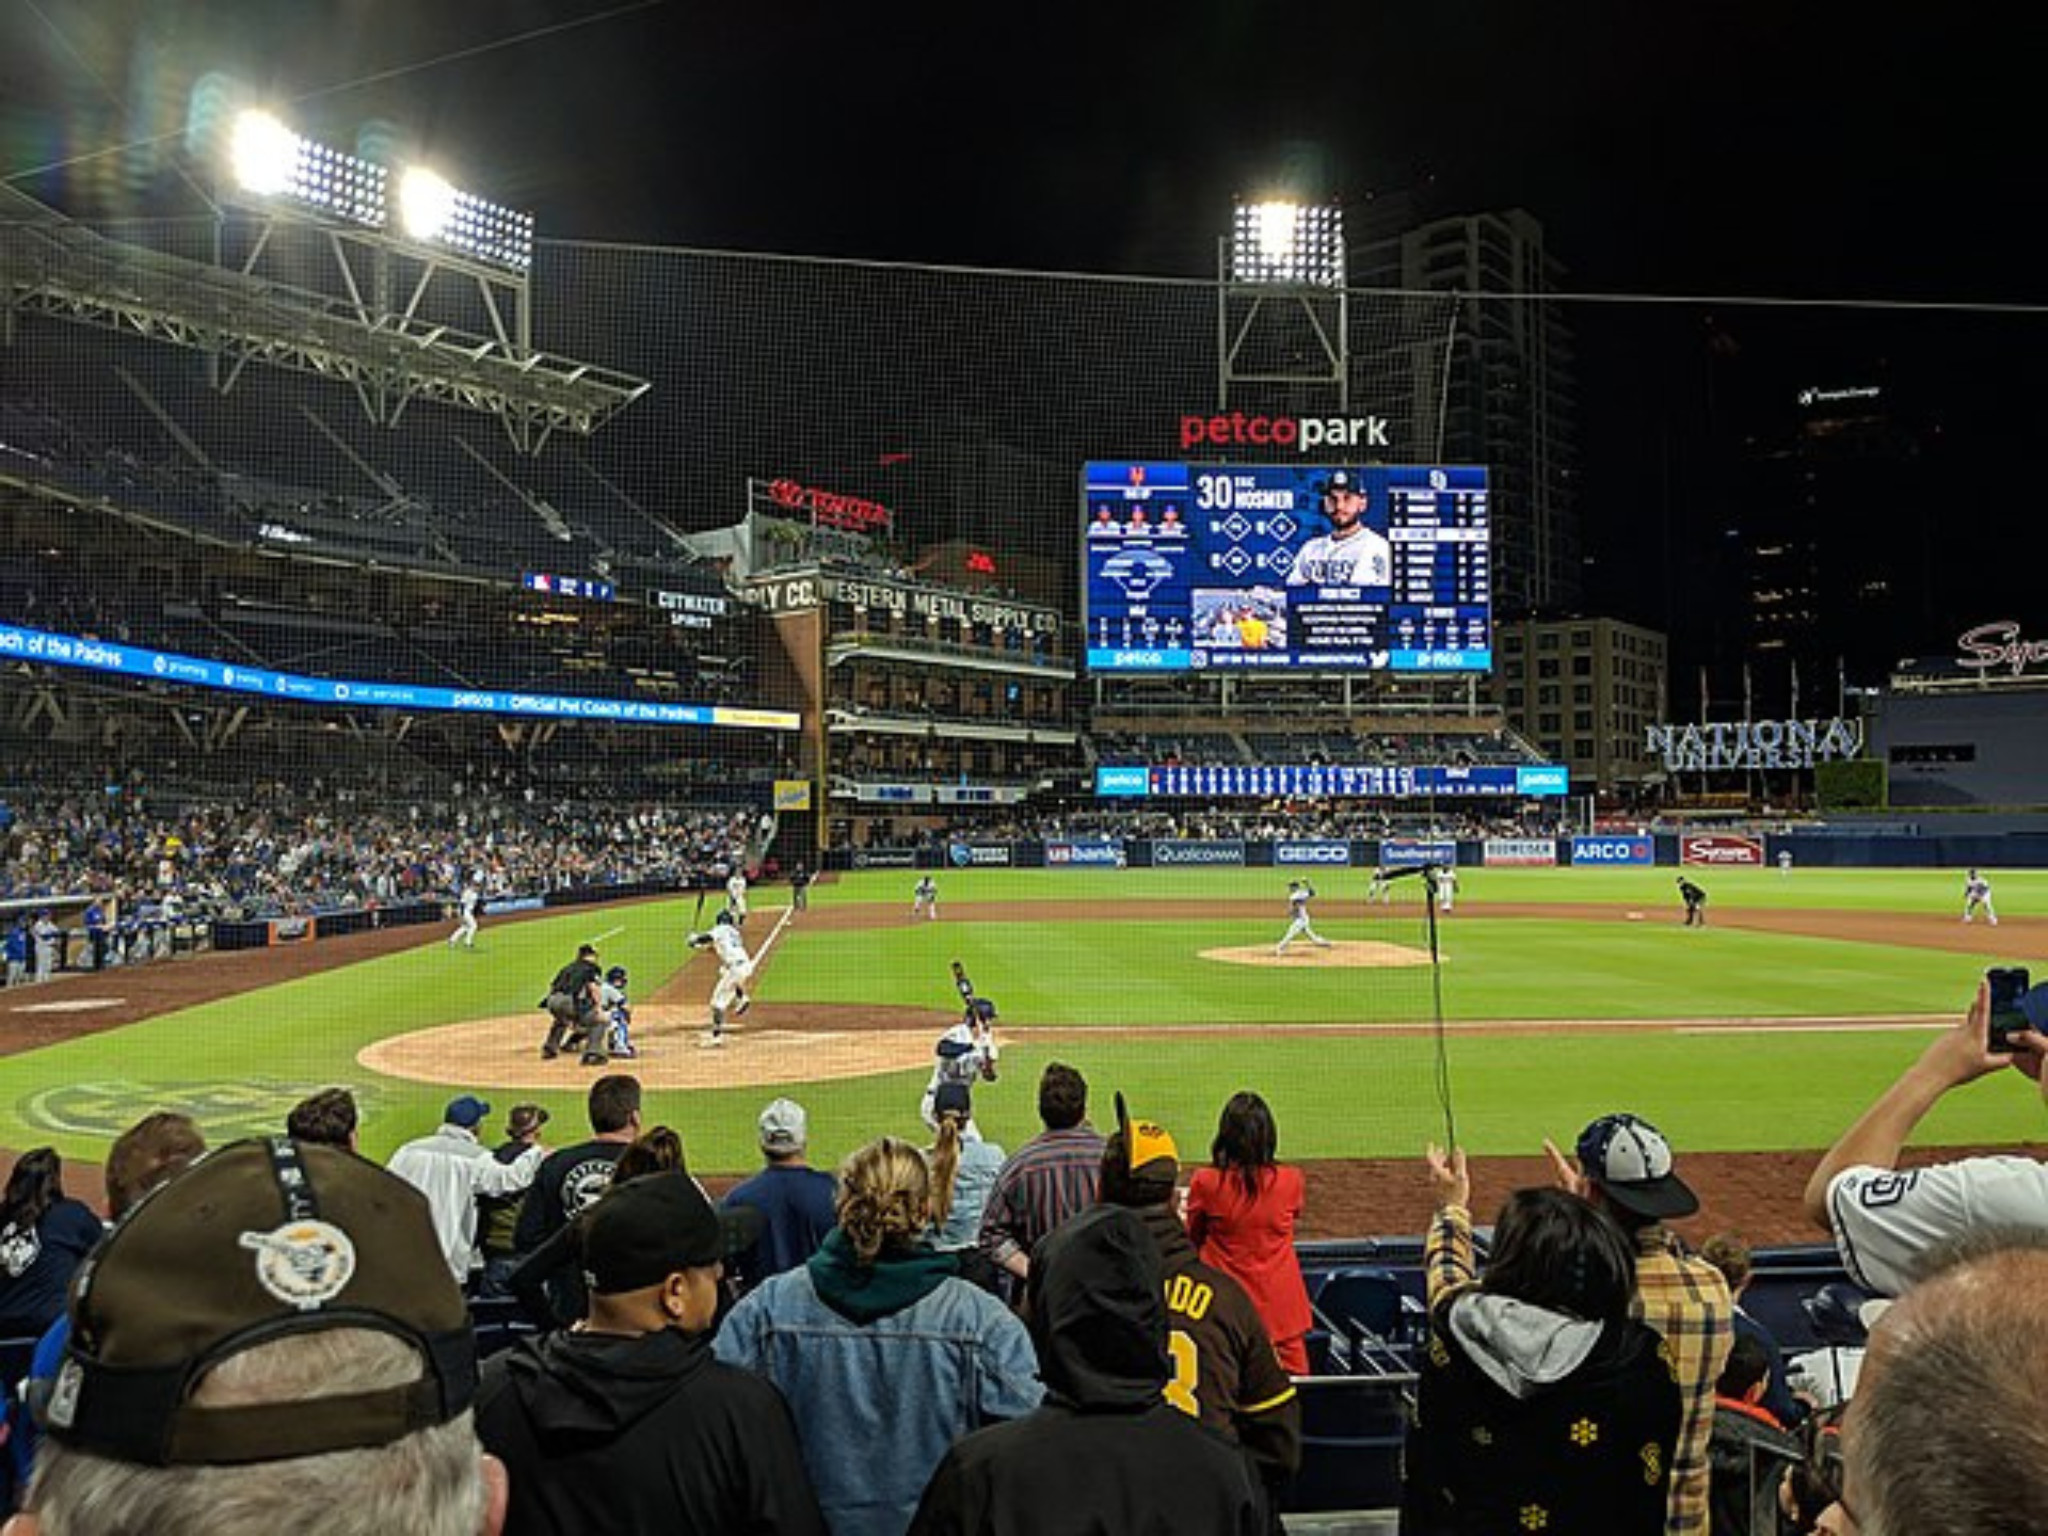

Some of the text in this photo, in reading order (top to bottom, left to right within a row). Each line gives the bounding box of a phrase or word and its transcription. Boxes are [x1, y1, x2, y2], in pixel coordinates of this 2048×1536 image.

[1197, 475, 1232, 509] 30
[786, 580, 818, 606] CO.
[28, 634, 45, 654] of
[47, 637, 71, 658] the
[74, 641, 122, 667] Padres
[1114, 651, 1162, 669] petco
[453, 691, 494, 710] petco
[509, 694, 698, 721] Official Pet Coach of the Padres
[1103, 772, 1144, 788] petco
[1155, 844, 1243, 862] Qualcomm
[1278, 846, 1348, 862] GEICO
[1573, 844, 1630, 858] ARCO
[1163, 1272, 1214, 1320] DO
